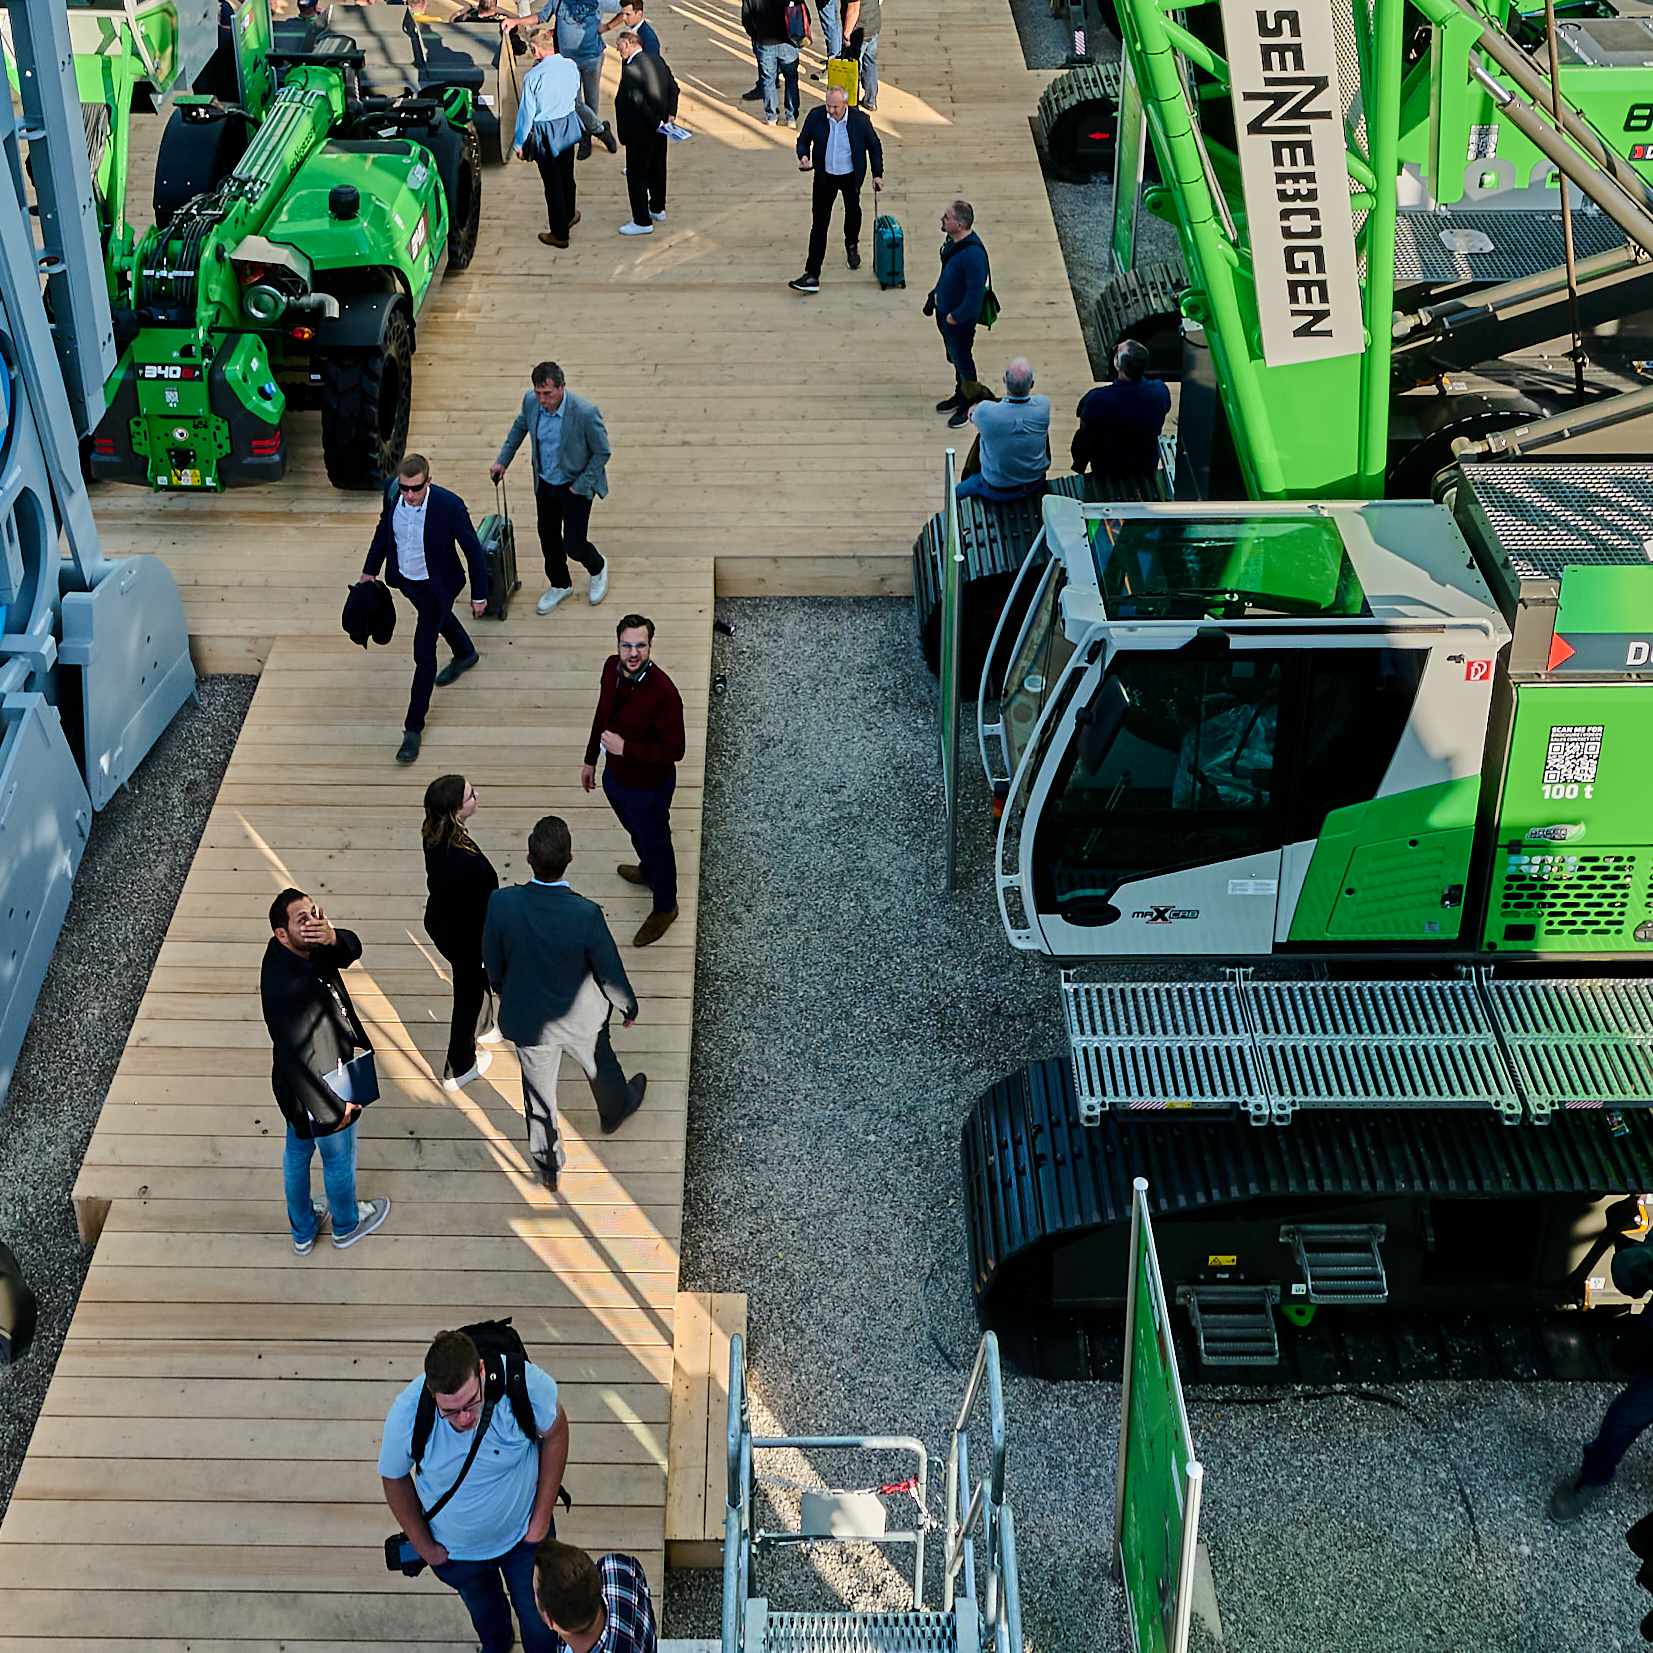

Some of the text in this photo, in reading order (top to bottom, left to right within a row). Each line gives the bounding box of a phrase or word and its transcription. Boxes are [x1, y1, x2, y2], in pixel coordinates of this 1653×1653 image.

[1242, 9, 1334, 339] SENNEBOGEN
[1542, 783, 1594, 800] 100 t
